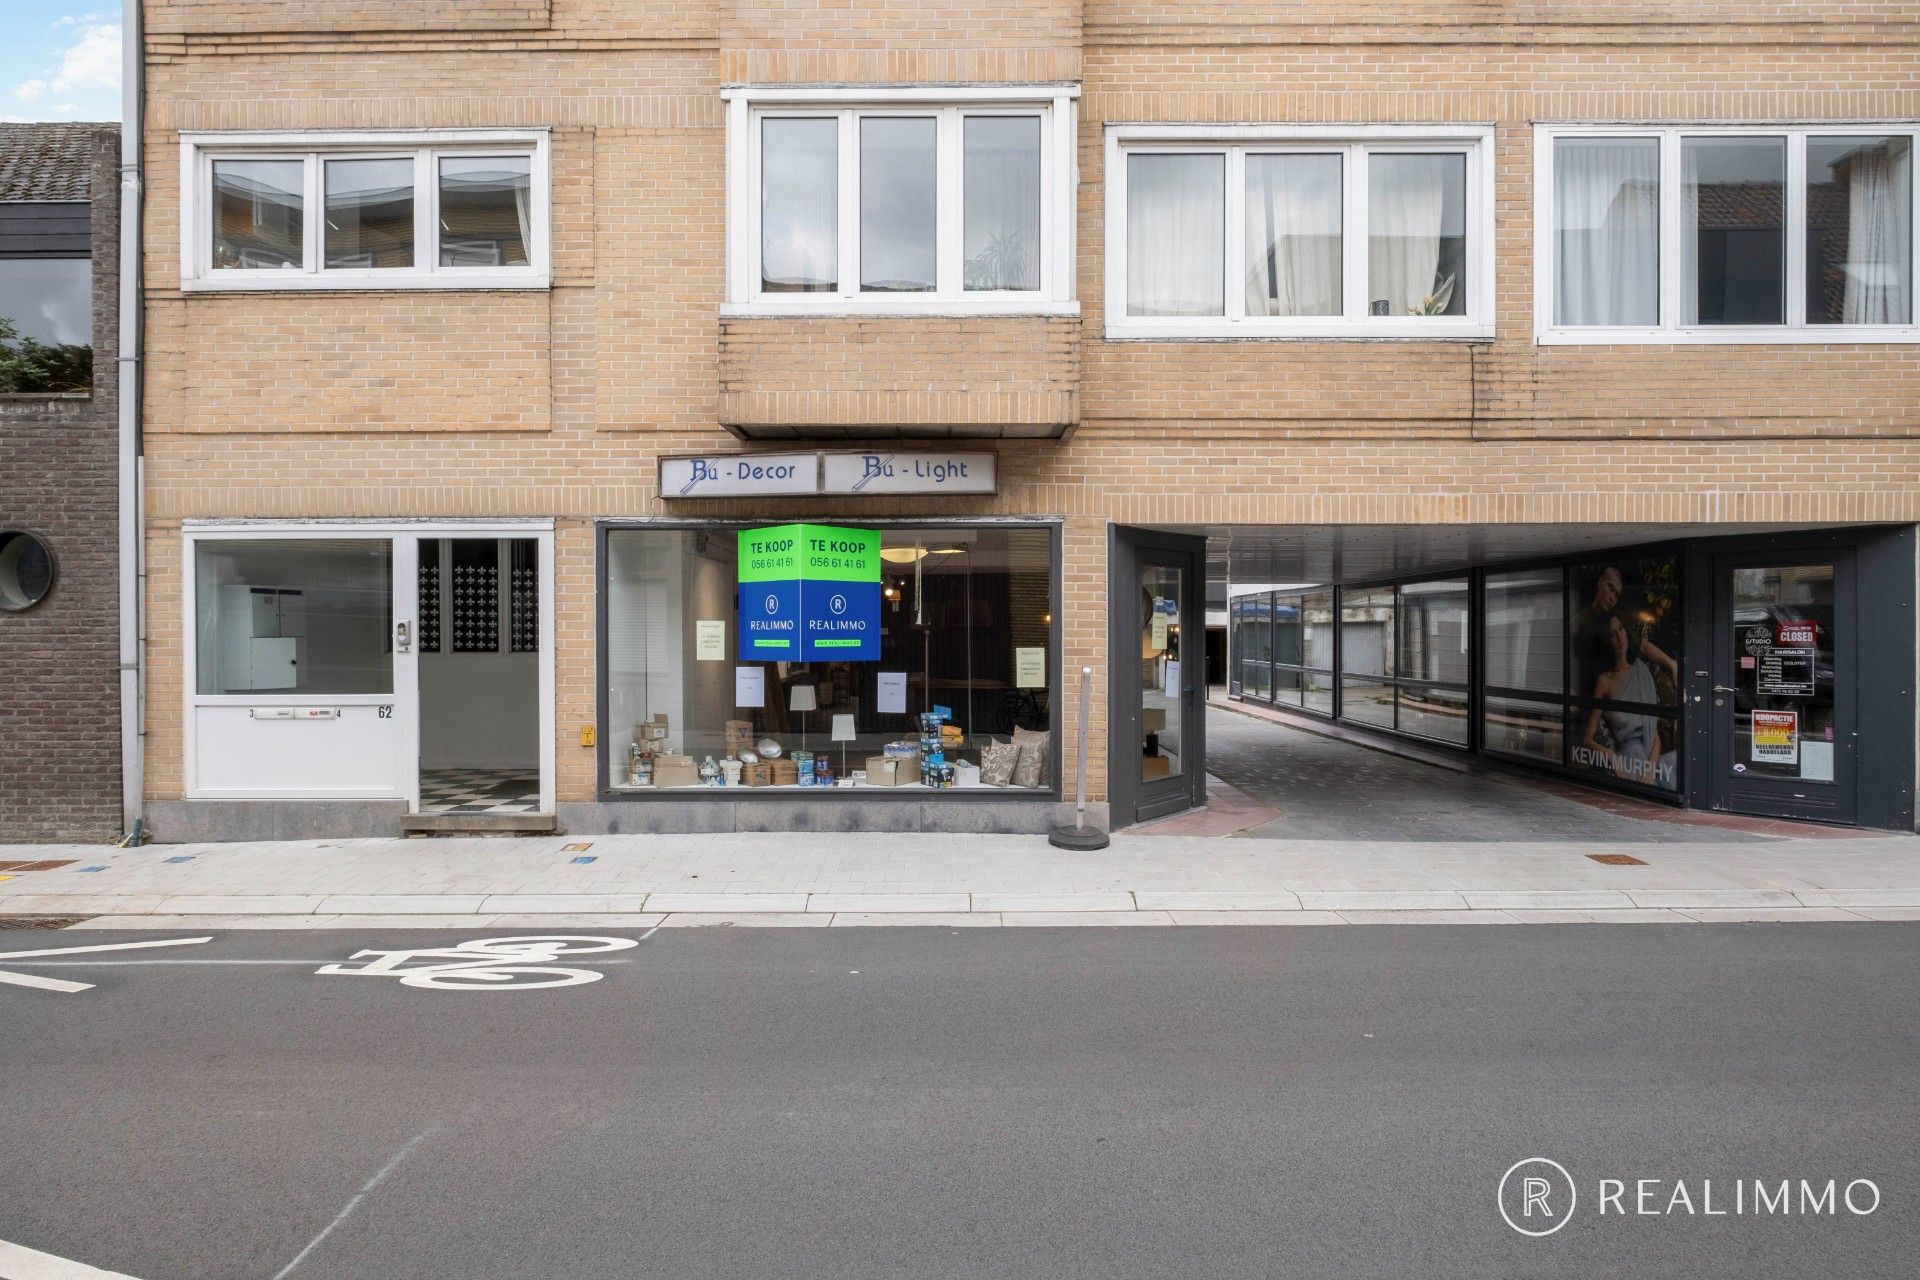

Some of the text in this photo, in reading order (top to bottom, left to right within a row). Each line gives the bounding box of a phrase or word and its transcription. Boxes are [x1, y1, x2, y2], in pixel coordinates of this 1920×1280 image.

[738, 462, 796, 480] Decor
[914, 459, 968, 482] Light
[751, 539, 793, 554] TE KOOP
[810, 539, 866, 554] TE KOOP
[751, 557, 793, 570] 056 61 41 61
[810, 557, 866, 569] 056 61 41 61
[750, 620, 794, 631] REALIMMO
[809, 619, 866, 631] REALIMMO
[1780, 631, 1813, 642] CLOSED
[249, 709, 254, 718] 3
[336, 709, 341, 718] 4
[378, 706, 392, 719] 62
[1755, 713, 1794, 722] KOOPACTIE
[1572, 746, 1673, 783] KEVIN.MURPHY
